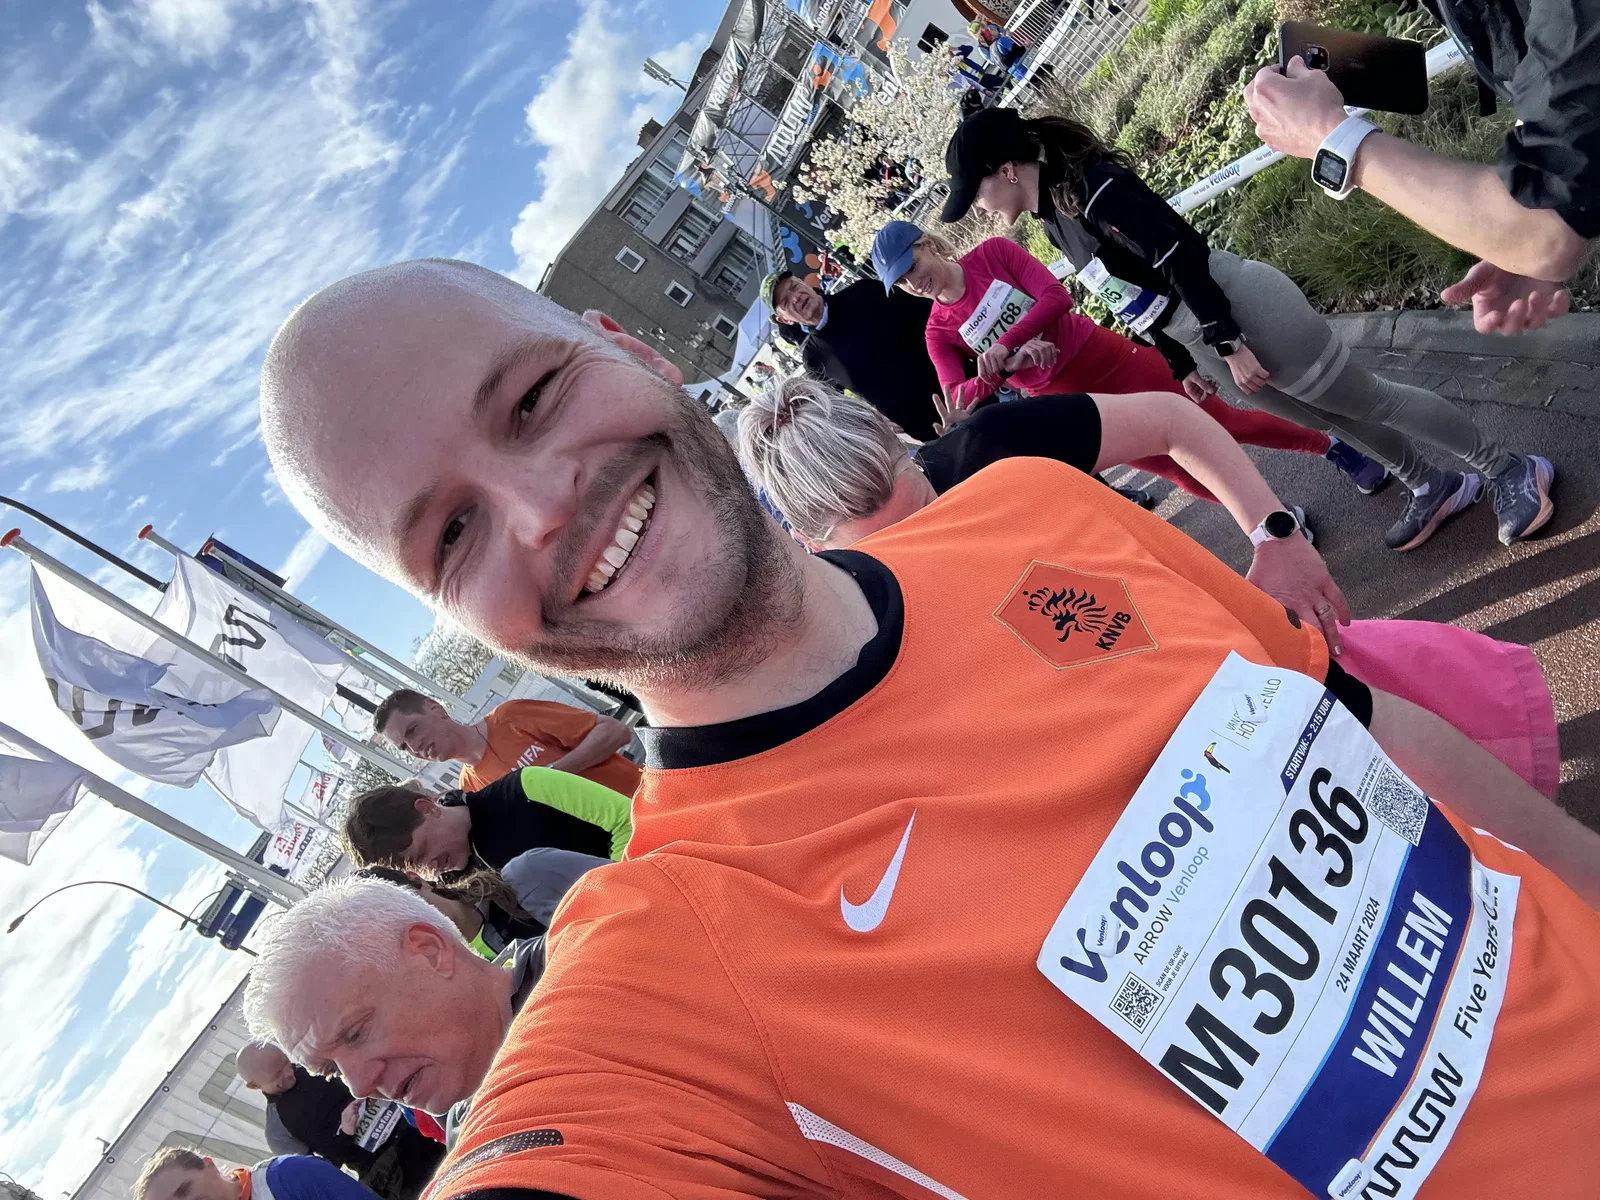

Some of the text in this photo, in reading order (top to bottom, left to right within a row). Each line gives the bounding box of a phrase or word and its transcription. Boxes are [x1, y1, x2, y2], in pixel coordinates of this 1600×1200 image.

[1101, 287, 1122, 304] 85
[1095, 611, 1132, 651] KNVB
[1285, 738, 1310, 780] STARTVAK:
[1309, 716, 1324, 733] 2:15
[1319, 697, 1332, 719] UUR
[1133, 846, 1210, 966] ARROW Venloop
[1159, 767, 1369, 1116] M30136
[1336, 896, 1381, 994] 24 MAART 2024
[1155, 944, 1183, 987] SCAN DE QR-CODE
[1162, 951, 1189, 992] VOOR JE UITSLAG
[1351, 890, 1454, 1078] WILLEM
[1453, 983, 1488, 1040] Five
[1473, 921, 1499, 980] Years
[371, 1109, 393, 1140] Stefan
